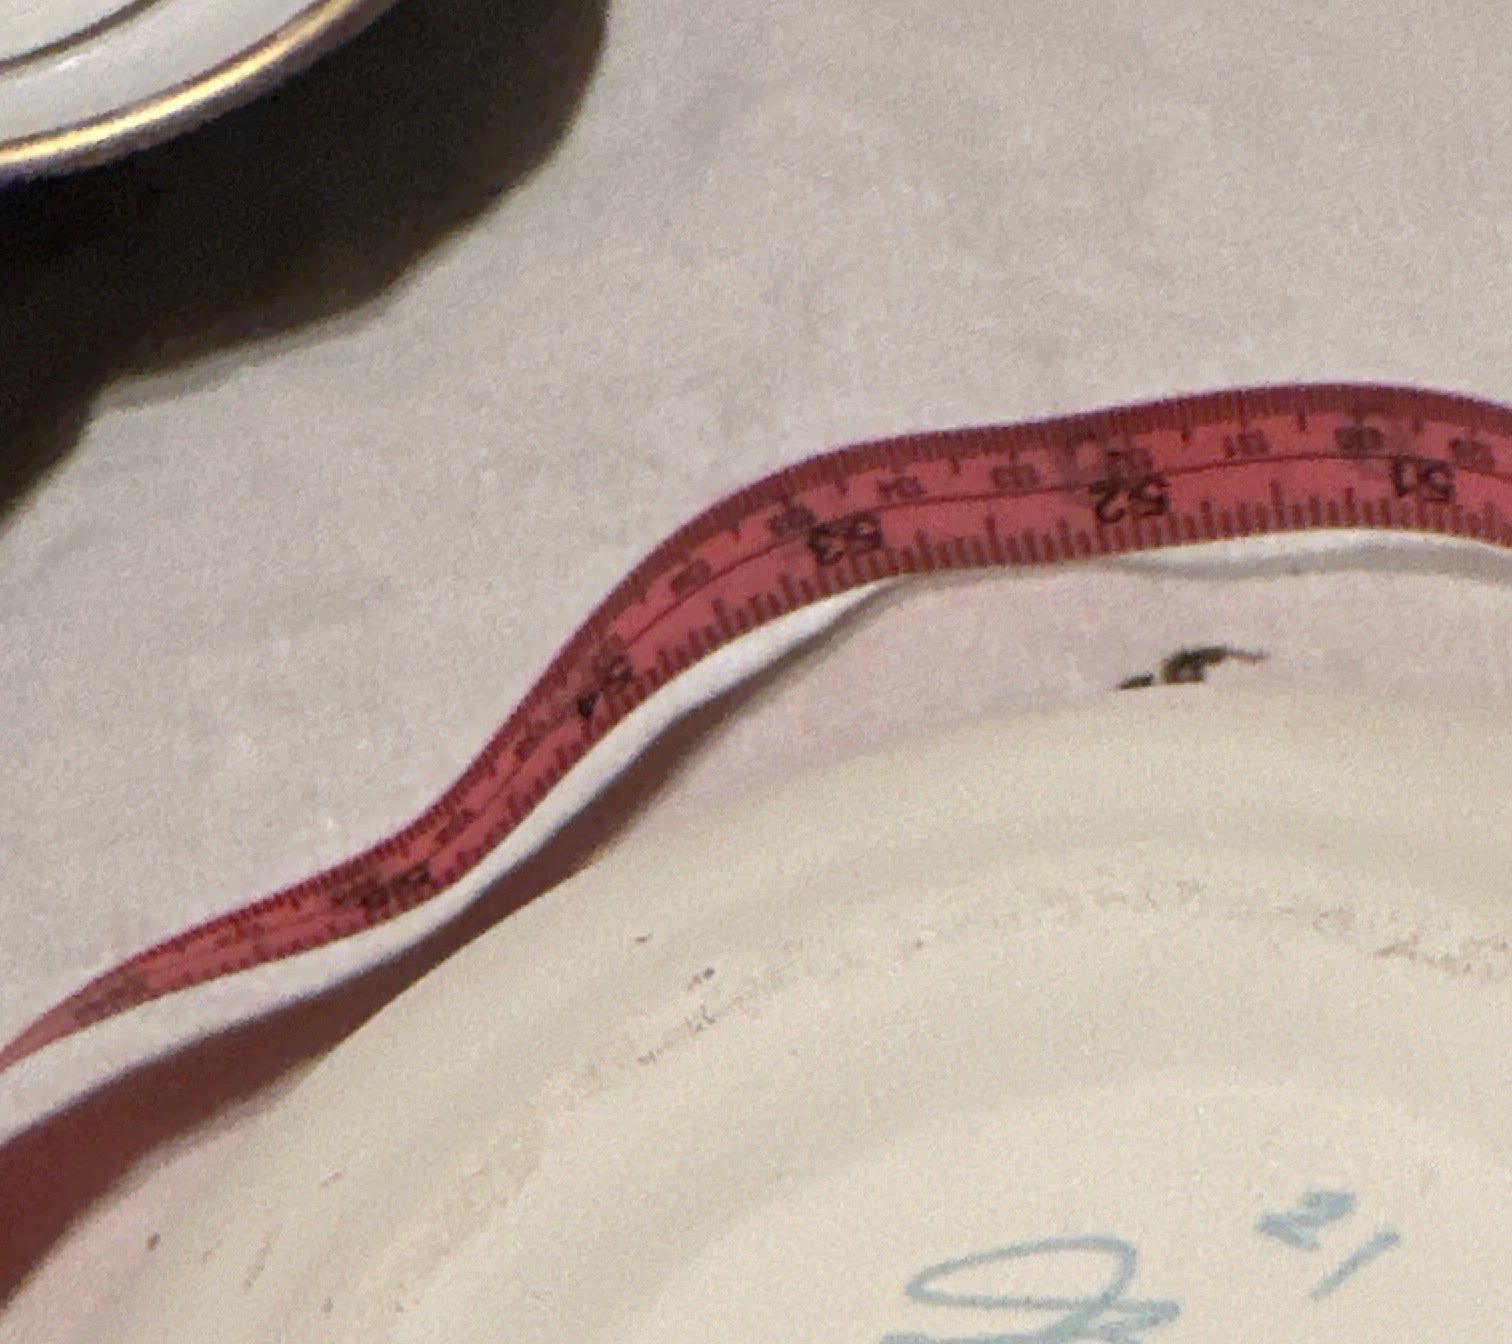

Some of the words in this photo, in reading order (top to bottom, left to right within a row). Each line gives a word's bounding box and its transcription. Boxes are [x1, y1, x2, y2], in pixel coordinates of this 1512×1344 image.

[1088, 472, 1170, 524] 52
[1390, 454, 1456, 502] 51
[805, 510, 883, 566] 53
